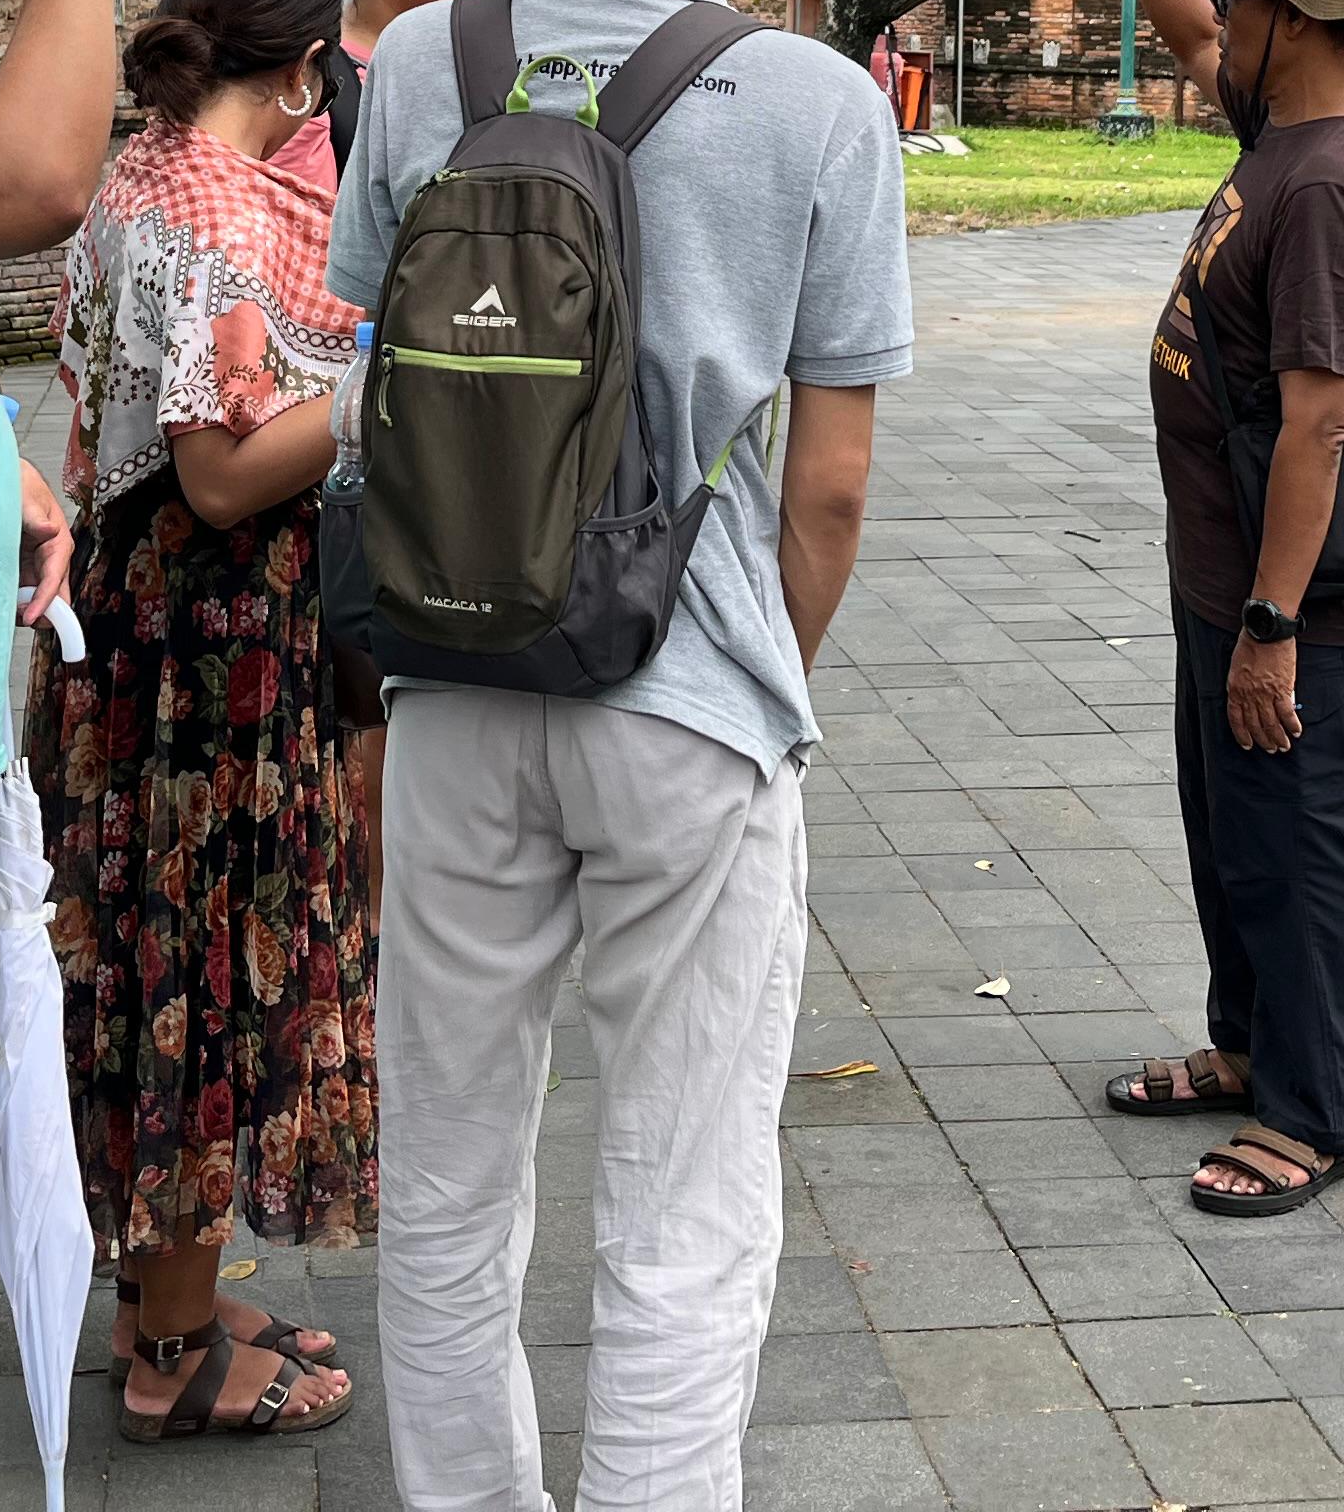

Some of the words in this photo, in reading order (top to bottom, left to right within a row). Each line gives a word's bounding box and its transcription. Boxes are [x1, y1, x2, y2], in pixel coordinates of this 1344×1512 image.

[452, 314, 517, 327] EIGER
[423, 595, 477, 612] MACACA
[480, 602, 493, 614] 12
